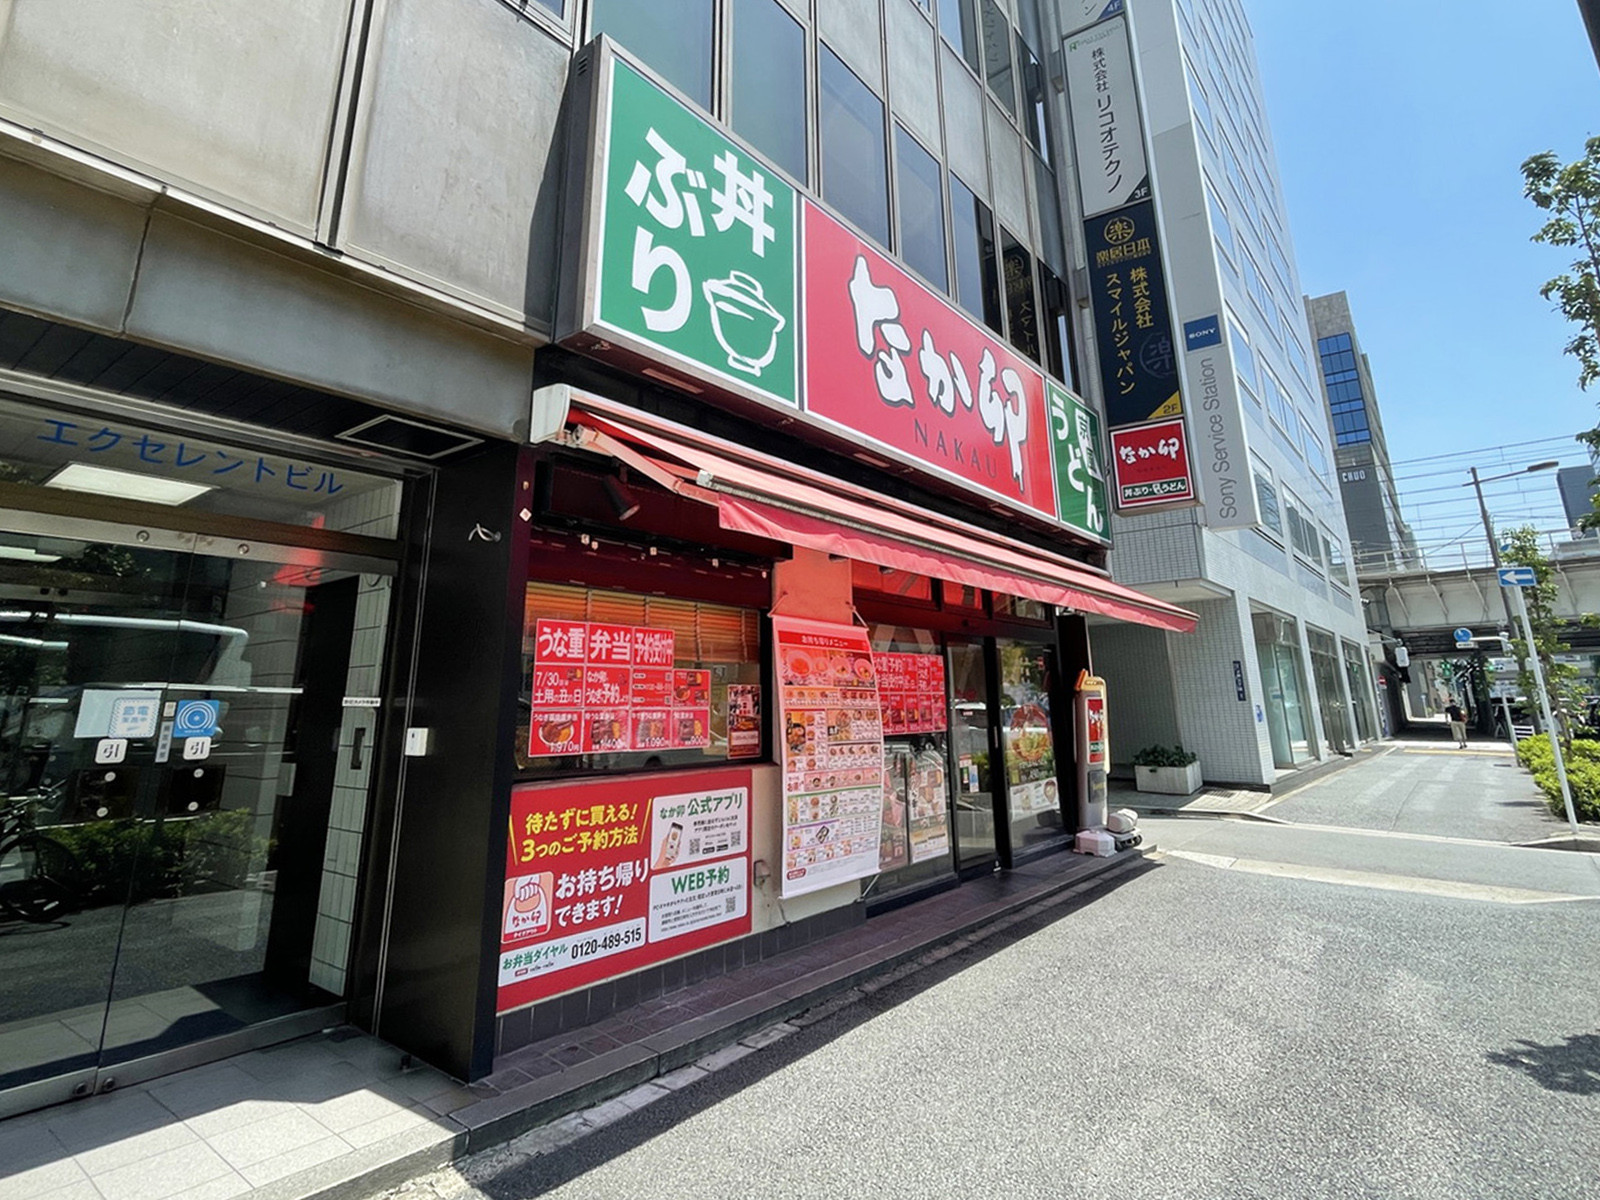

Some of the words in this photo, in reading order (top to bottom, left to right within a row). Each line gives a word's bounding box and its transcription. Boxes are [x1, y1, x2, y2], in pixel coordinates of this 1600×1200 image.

[1134, 187, 1149, 199] 3F
[1130, 266, 1154, 329] 株式会社
[1106, 273, 1136, 395] スマイルジャパン
[1189, 327, 1217, 339] SONY
[849, 255, 1028, 492] なか卯
[1199, 358, 1219, 411] Station
[1162, 404, 1179, 415] 2F
[38, 418, 345, 495] エクセレントビル
[914, 418, 998, 479] NAKAU
[1052, 391, 1103, 533] うどん
[1208, 414, 1230, 473] Service
[1220, 477, 1237, 519] Sony
[539, 626, 586, 659] うな重
[590, 629, 632, 662] 弁当
[103, 743, 120, 759] 引
[190, 741, 205, 756] 引
[525, 803, 638, 834] 待たずに買える！
[687, 792, 743, 816] 公式アプリ
[520, 825, 638, 862] 3つのご予約方法
[555, 857, 649, 900] お持ち帰り
[671, 865, 730, 895] WEB予約
[555, 894, 623, 927] できます！
[502, 943, 569, 971] お弁当ダイヤル
[571, 926, 642, 960] 0120-489-515
